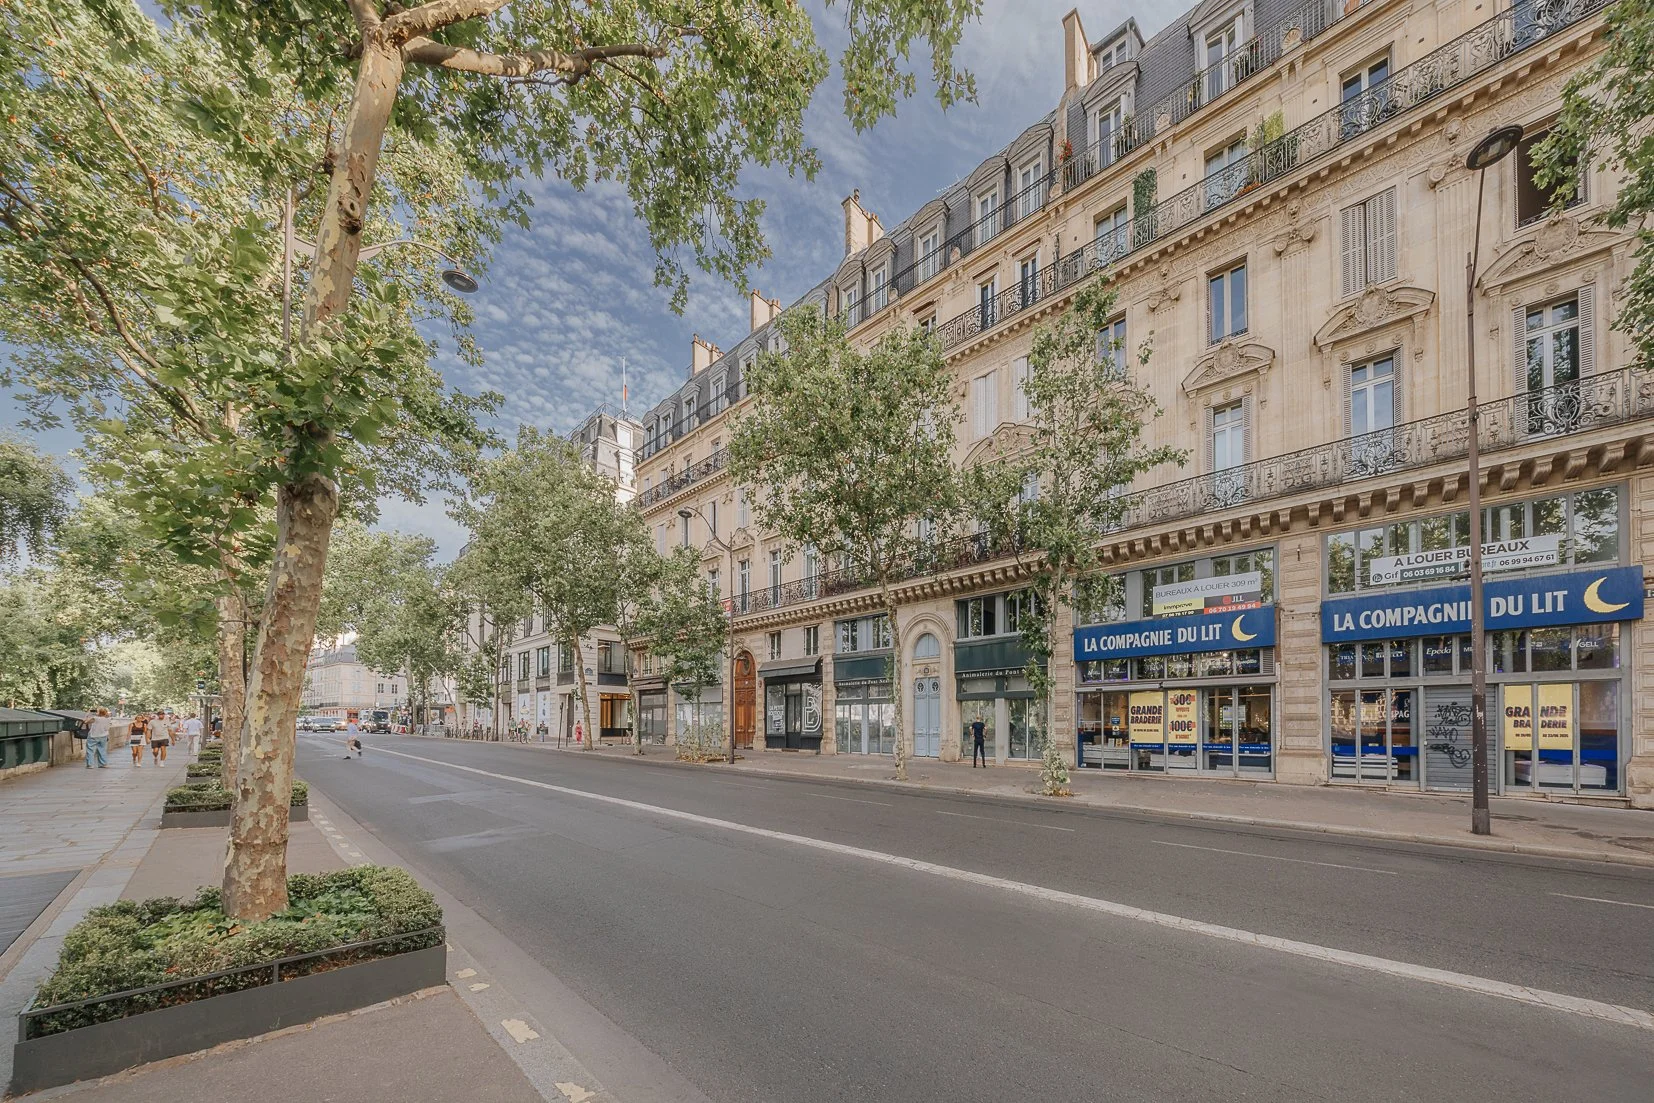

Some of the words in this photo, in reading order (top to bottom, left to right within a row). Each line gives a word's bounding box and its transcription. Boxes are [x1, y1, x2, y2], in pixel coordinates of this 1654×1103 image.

[1394, 558, 1404, 567] A
[1407, 552, 1452, 565] LOUER
[1156, 588, 1192, 598] BUREAUX
[1201, 582, 1229, 591] LOUER
[1334, 613, 1355, 632] LA
[1360, 601, 1472, 629] COMPAGNI
[1491, 595, 1523, 617] DU
[1532, 590, 1568, 614] LIT
[1084, 638, 1097, 652] LA
[1100, 630, 1172, 651] COMPAGNIE
[1178, 627, 1196, 643] DU
[1202, 624, 1222, 641] LIT
[1426, 647, 1451, 656] Epeda
[1130, 706, 1162, 715] GRANDE
[1130, 716, 1161, 724] BRADERIE
[1170, 720, 1192, 731] 100€
[1541, 720, 1567, 728] DERIE
